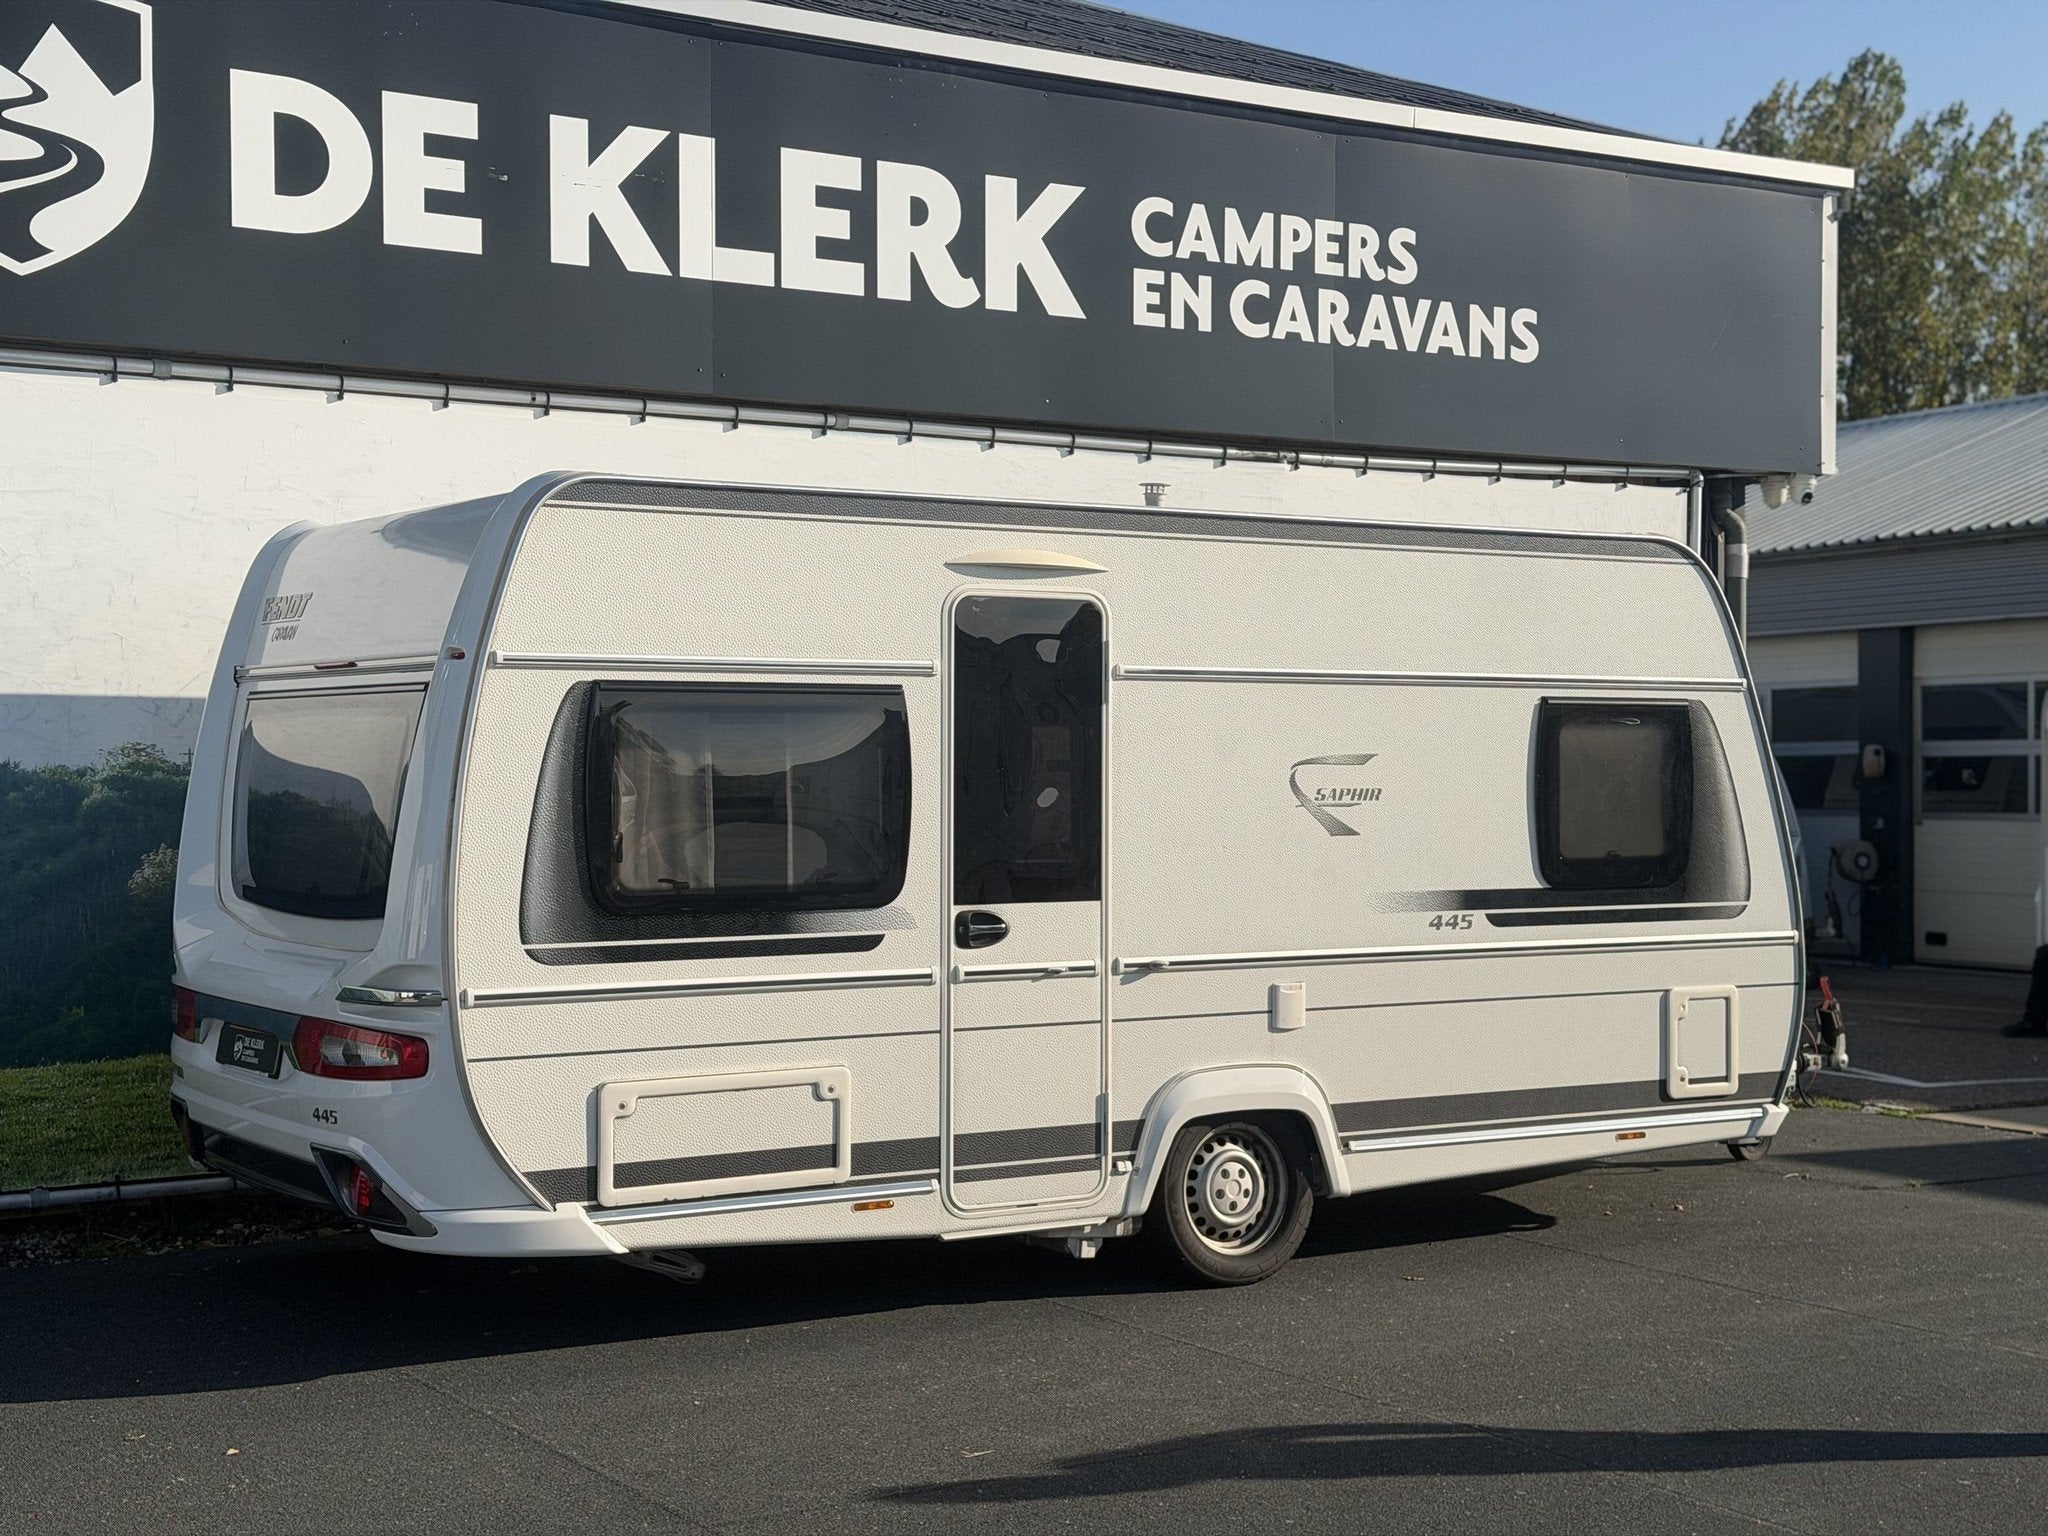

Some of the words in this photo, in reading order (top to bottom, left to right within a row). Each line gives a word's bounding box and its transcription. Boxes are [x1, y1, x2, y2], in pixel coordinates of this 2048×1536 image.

[229, 68, 483, 255] DE
[549, 113, 1086, 320] KLERK
[1130, 197, 1418, 285] CAMPERS
[1132, 267, 1212, 333] EN
[1229, 279, 1540, 364] CARAVANS
[262, 592, 313, 622] FENDT
[1313, 787, 1383, 802] SAPHIR
[1428, 913, 1475, 931] 445
[312, 1107, 338, 1125] 445
